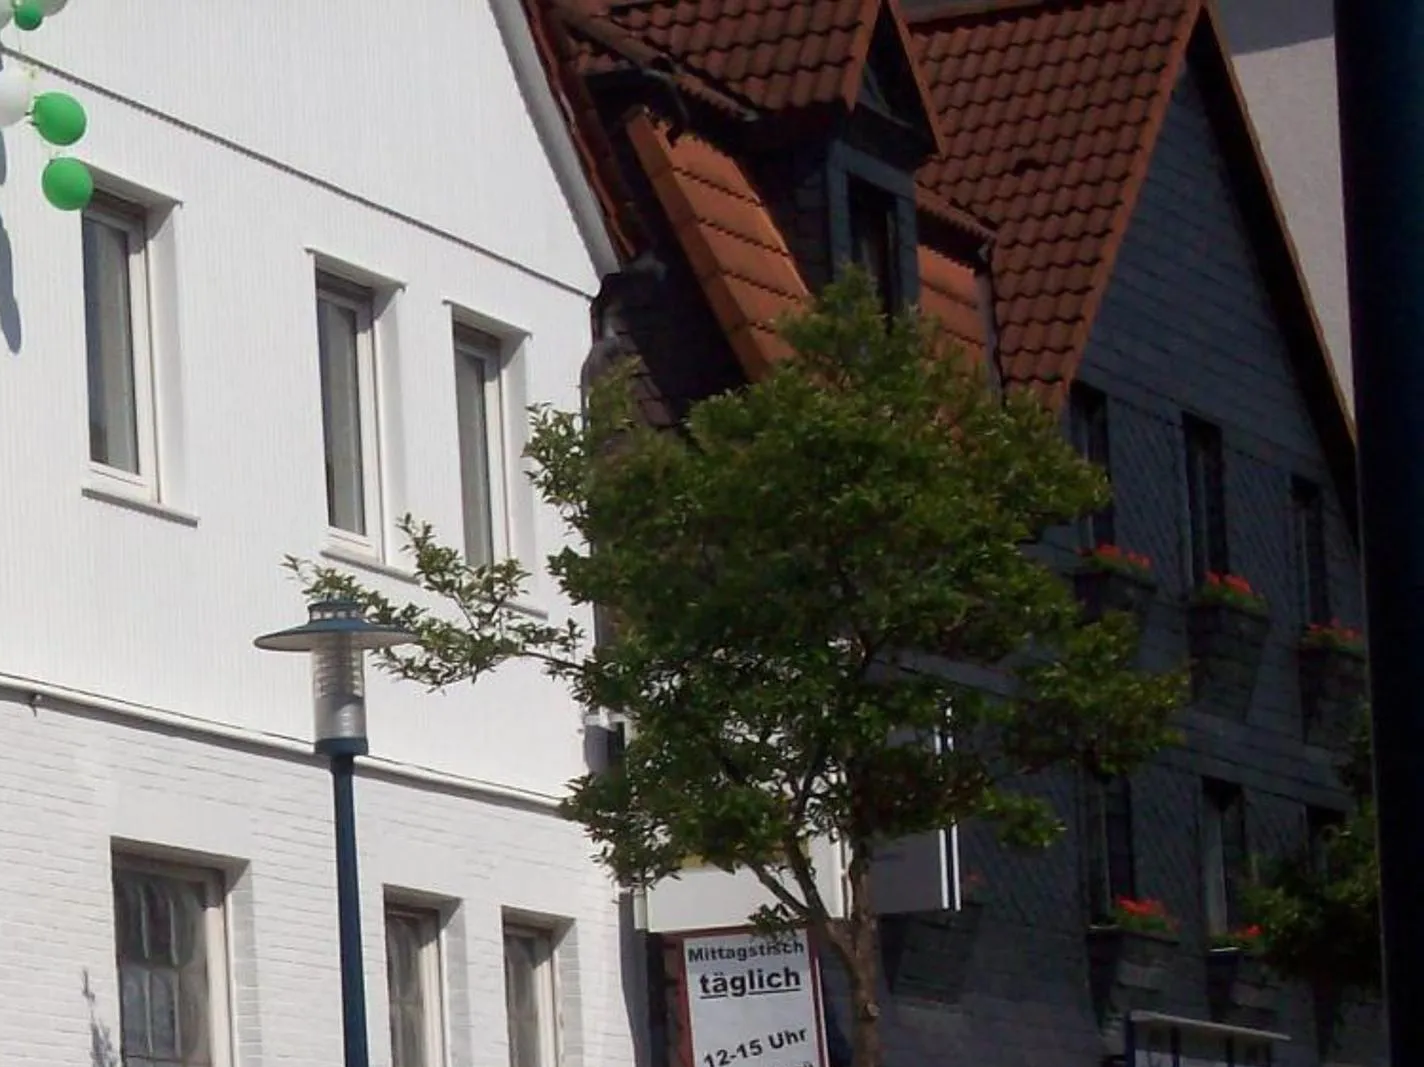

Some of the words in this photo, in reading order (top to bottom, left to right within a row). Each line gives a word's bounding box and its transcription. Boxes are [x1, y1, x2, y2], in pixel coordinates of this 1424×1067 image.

[688, 940, 804, 962] Mittagstisch
[700, 966, 801, 997] täglich
[769, 1028, 808, 1050] Uhr
